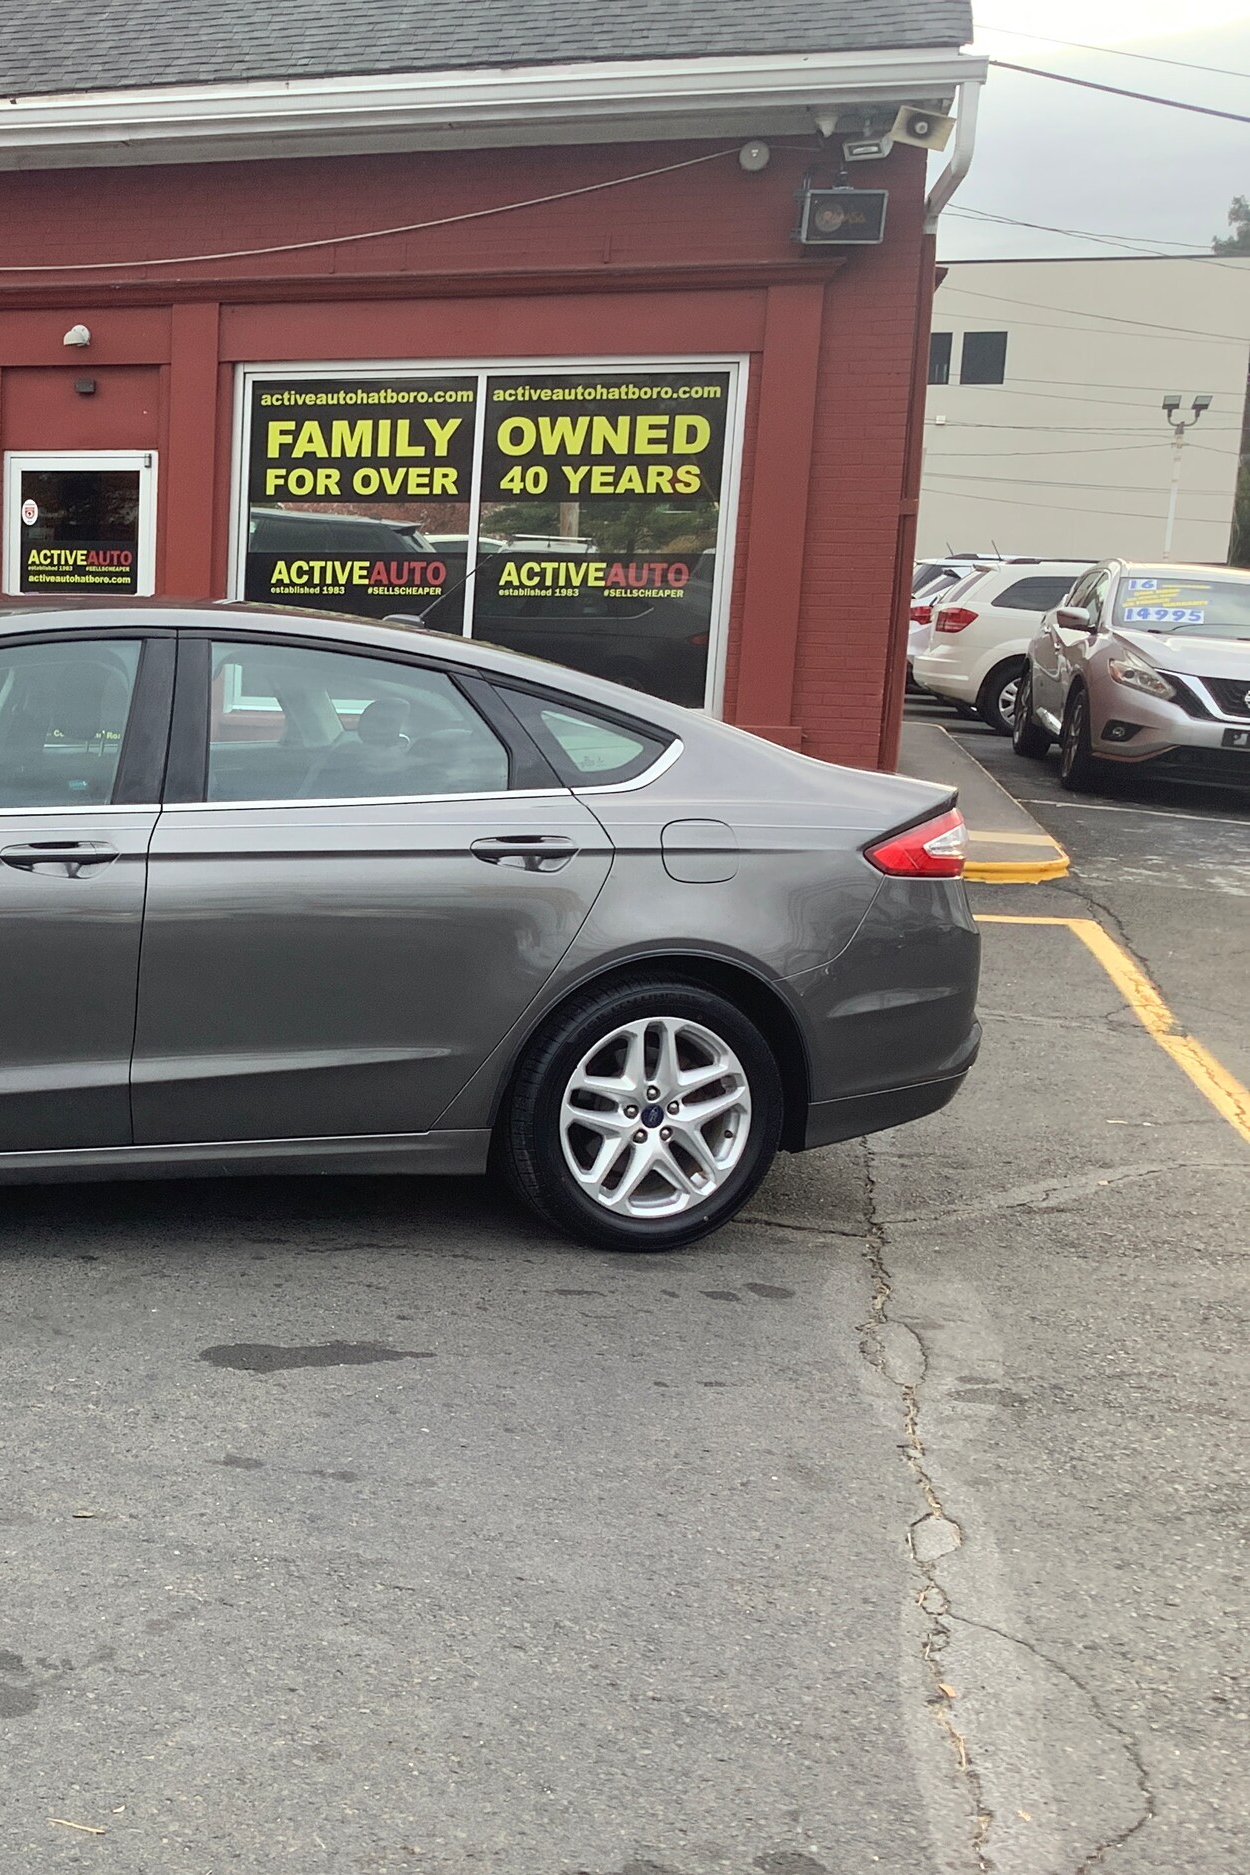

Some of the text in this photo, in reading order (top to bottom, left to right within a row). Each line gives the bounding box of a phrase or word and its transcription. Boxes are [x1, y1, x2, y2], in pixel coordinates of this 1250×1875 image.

[260, 389, 474, 406] activeautohatboro.com
[492, 384, 721, 402] activeautohatboro.com
[267, 418, 463, 459] FAMILY
[496, 415, 711, 456] OWNED
[265, 467, 459, 496] FOR OVER
[499, 465, 701, 494] 40 YEARS
[28, 574, 131, 584] activeautohatboro.com
[1130, 580, 1155, 589] 16
[270, 586, 442, 596] established 1983 #SELLSCHEAPER
[498, 588, 684, 599] established 1983 #SELLSCHEAPER
[1126, 608, 1202, 622] 14995
